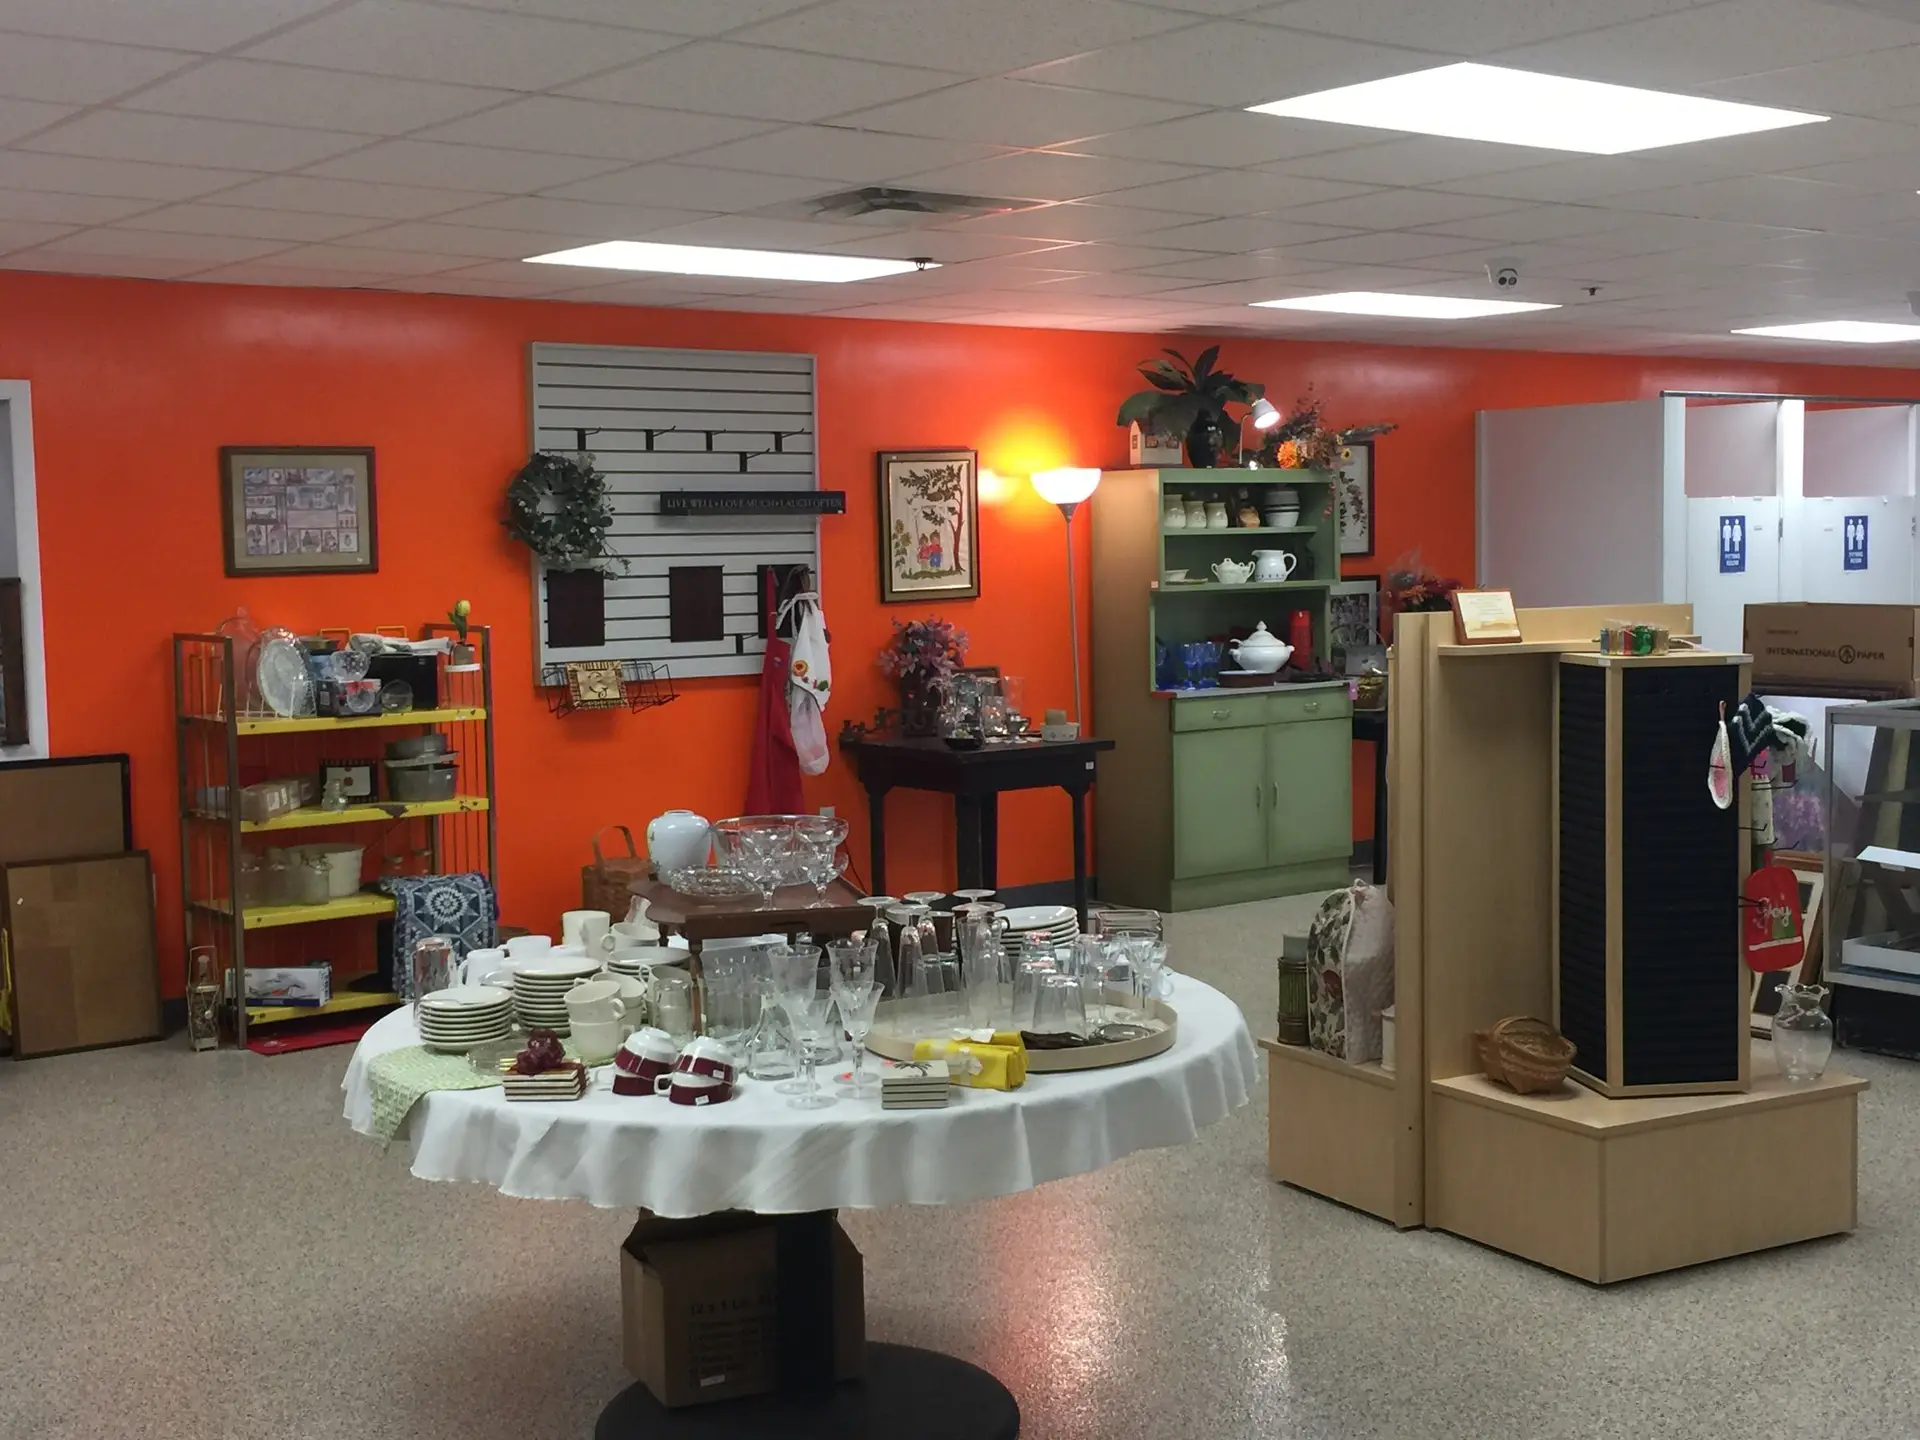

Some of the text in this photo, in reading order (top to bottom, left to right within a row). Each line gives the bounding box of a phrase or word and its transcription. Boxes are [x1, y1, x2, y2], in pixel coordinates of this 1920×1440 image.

[667, 499, 688, 508] LIVE
[1765, 647, 1884, 660] INTERNATIONAL PAPER
